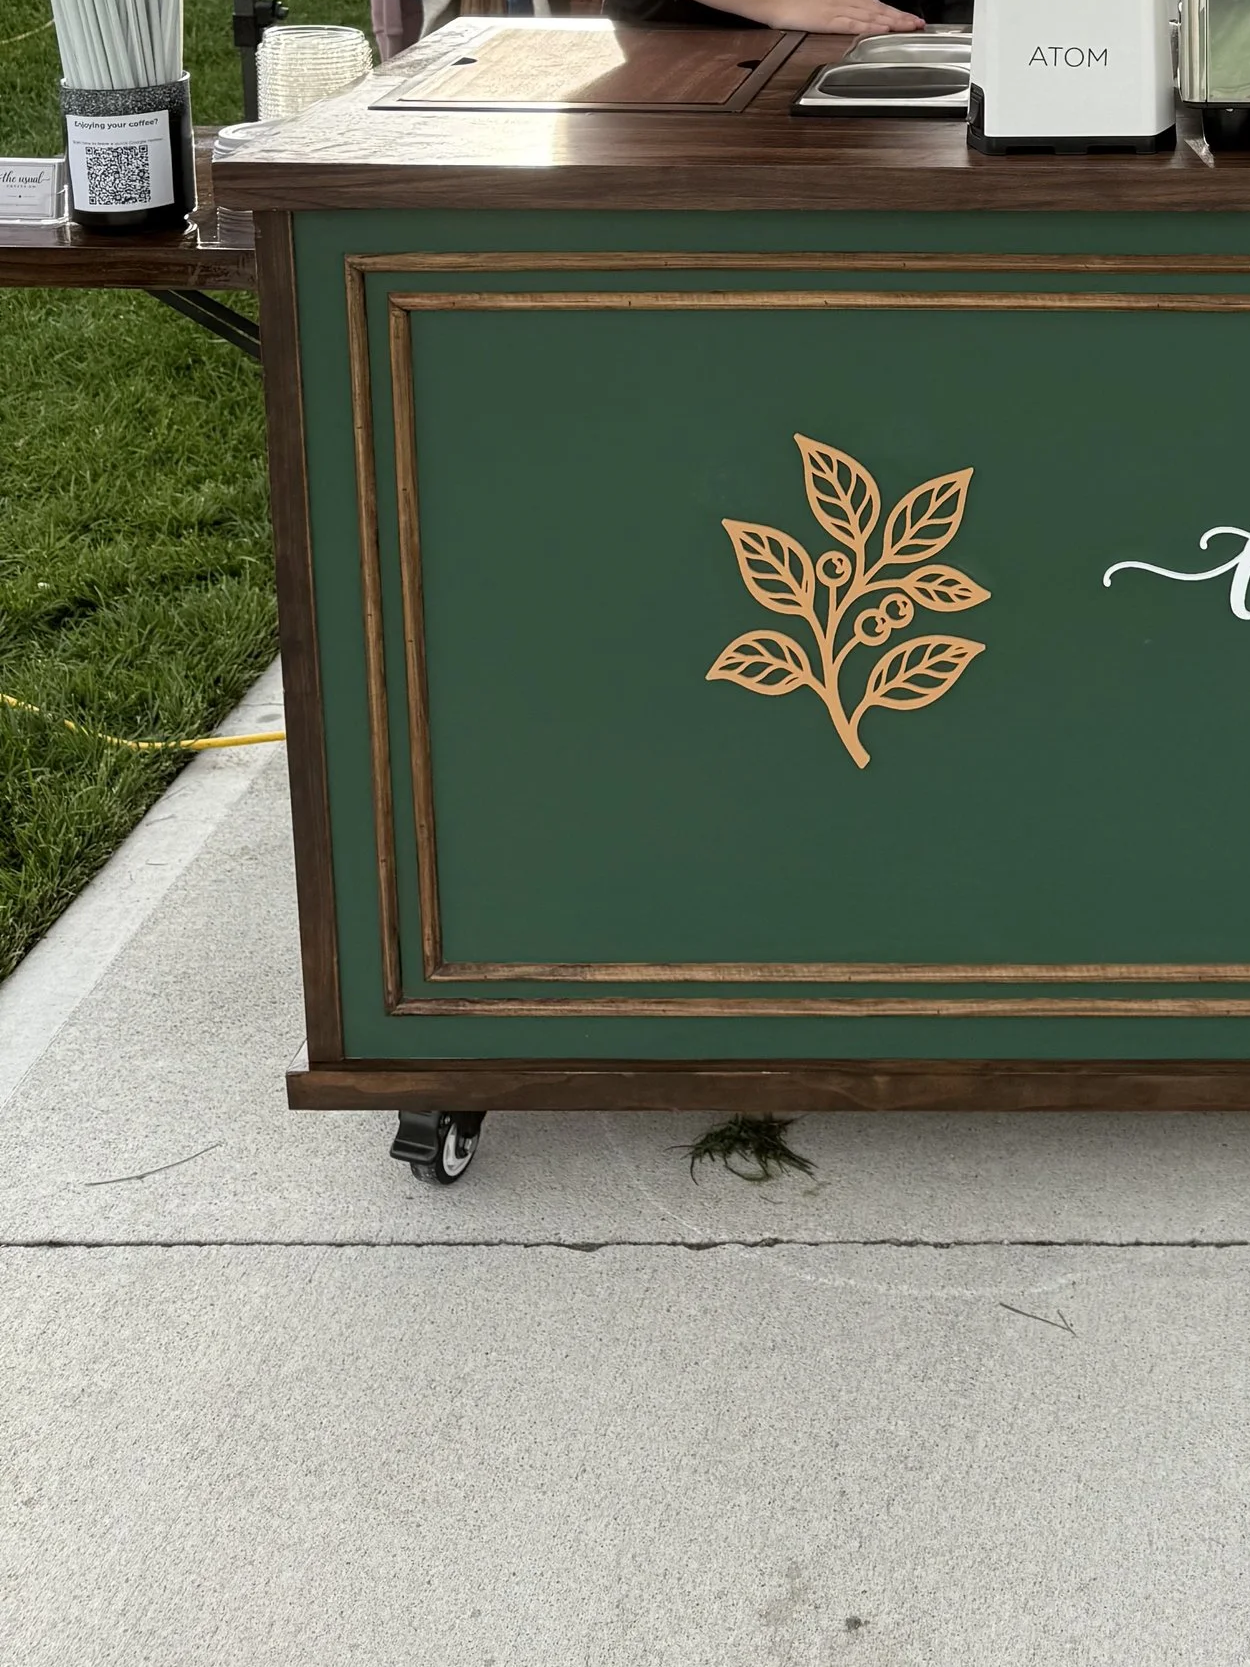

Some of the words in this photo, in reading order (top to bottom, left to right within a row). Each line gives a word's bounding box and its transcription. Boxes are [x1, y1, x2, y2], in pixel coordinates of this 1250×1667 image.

[1028, 46, 1107, 67] ATOM
[74, 120, 106, 130] Enjoying
[107, 121, 127, 130] your
[128, 118, 158, 128] coffee?
[0, 170, 16, 183] the
[18, 170, 50, 184] usual
